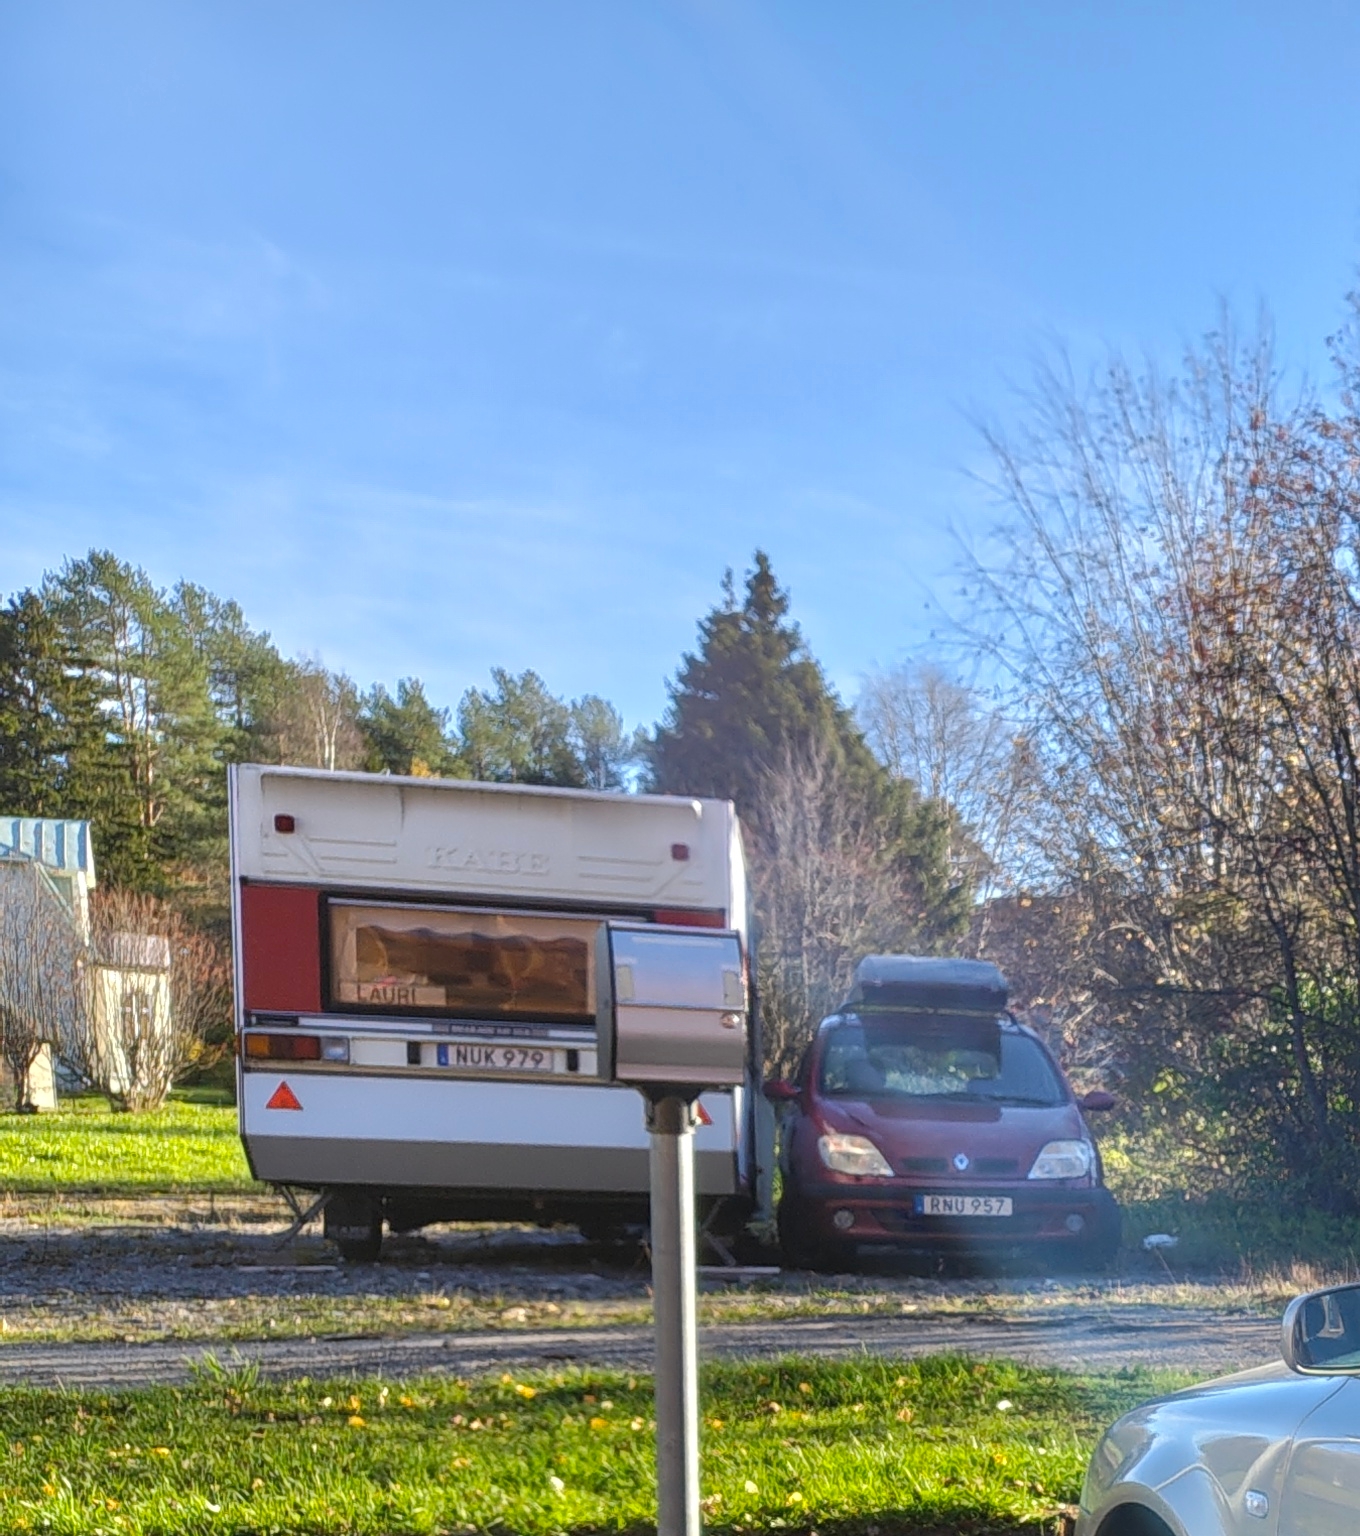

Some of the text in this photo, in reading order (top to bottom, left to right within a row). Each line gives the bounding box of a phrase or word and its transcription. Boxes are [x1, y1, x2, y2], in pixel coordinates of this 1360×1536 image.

[426, 847, 551, 876] KABE
[456, 1045, 544, 1069] NUK 979
[930, 1197, 1005, 1214] RNU 957
